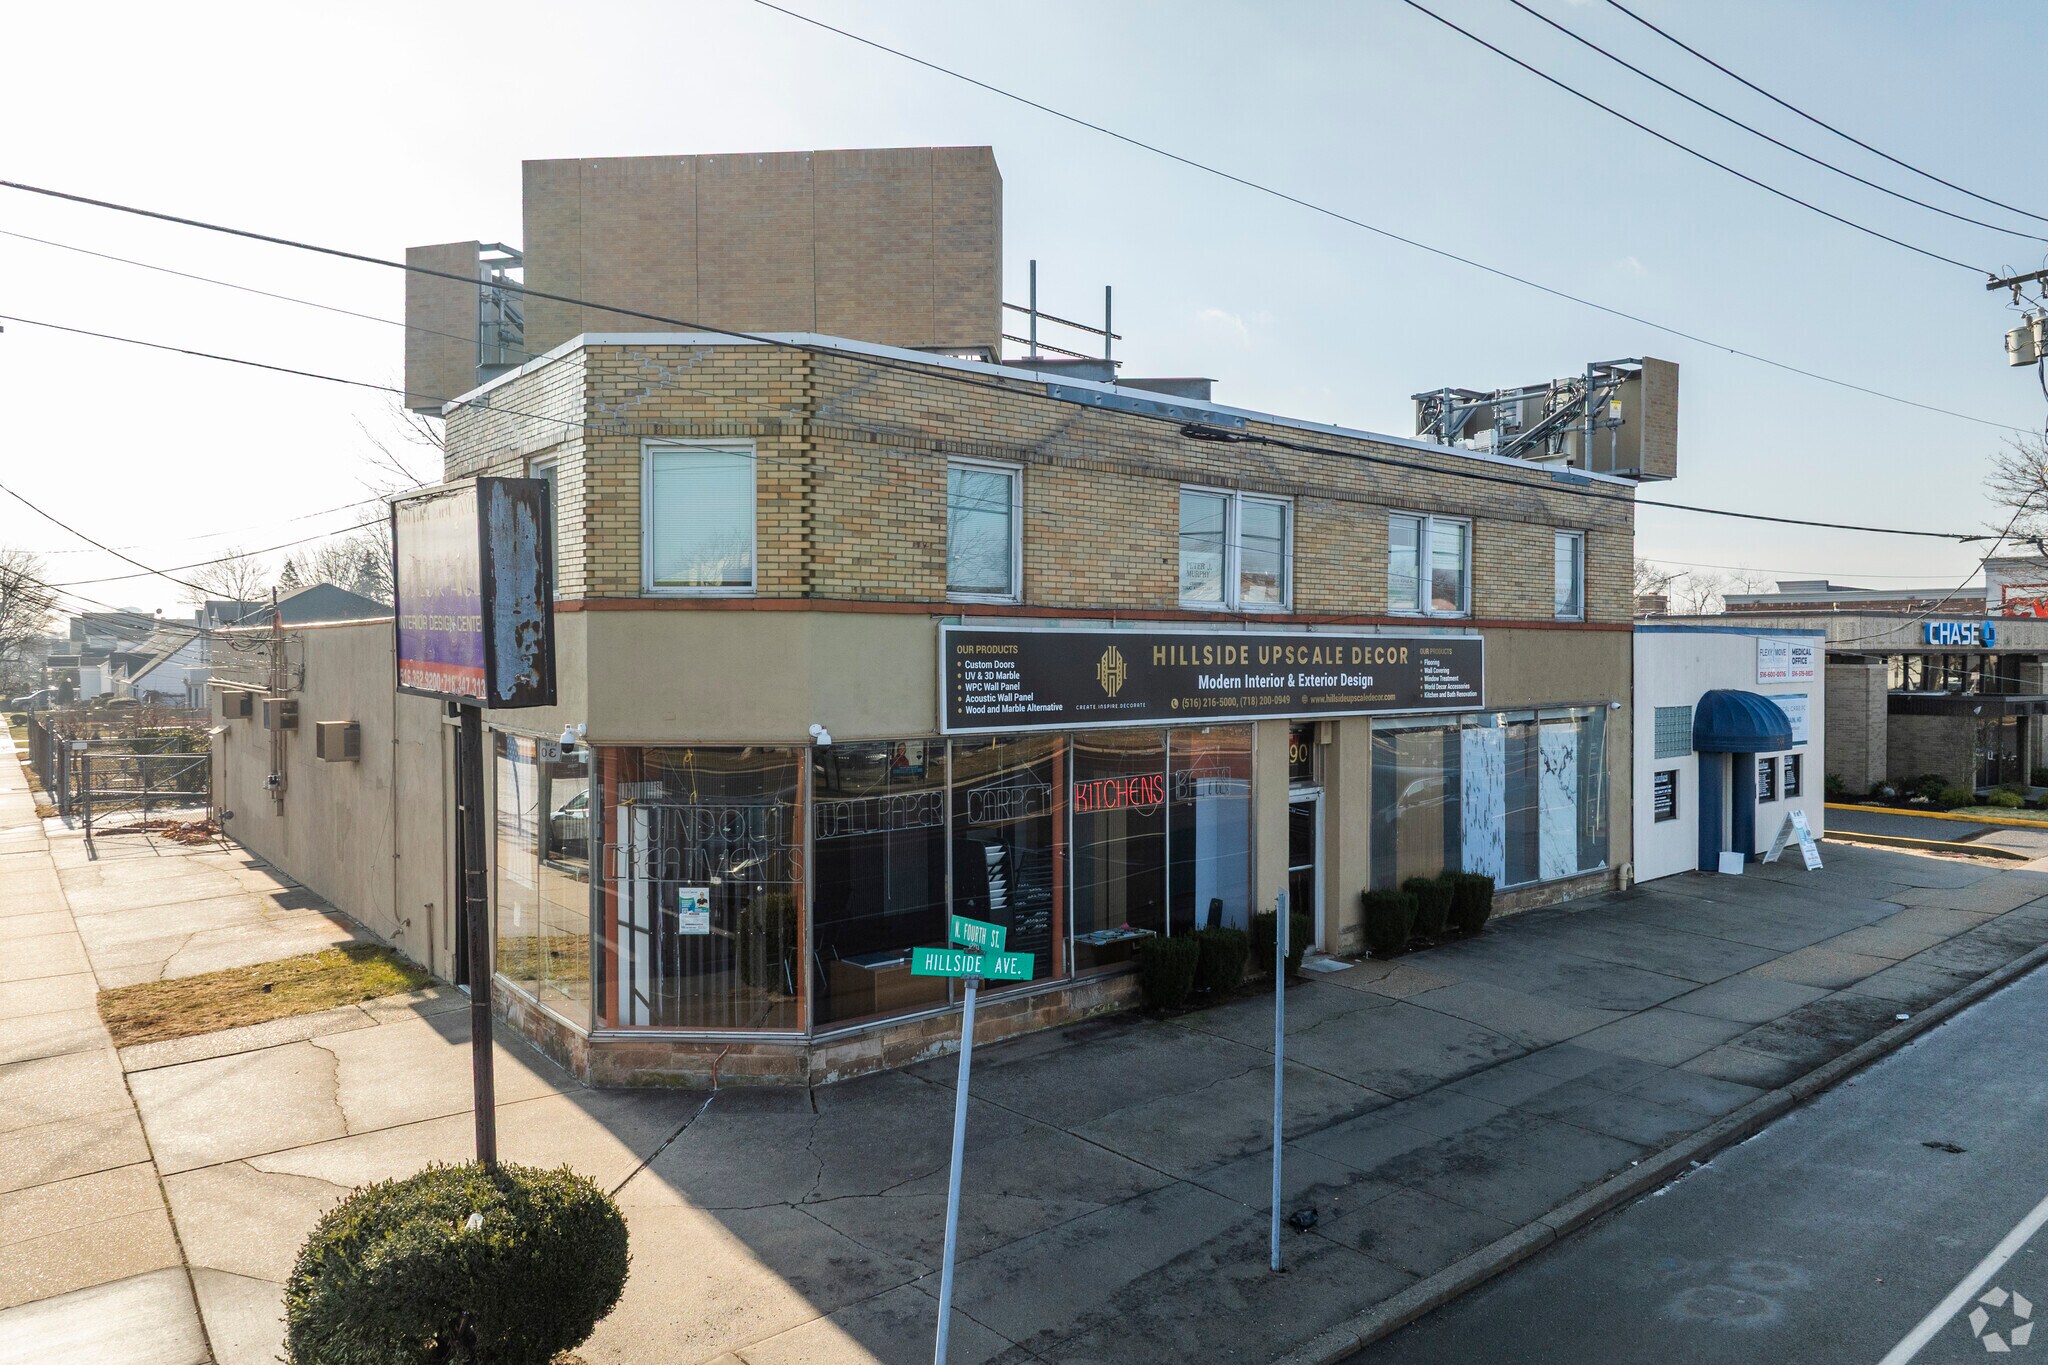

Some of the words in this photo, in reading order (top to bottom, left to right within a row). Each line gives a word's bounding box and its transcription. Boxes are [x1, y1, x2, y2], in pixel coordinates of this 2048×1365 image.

[430, 615, 456, 630] DESIGN
[457, 616, 482, 632] CENTE
[1929, 622, 1980, 645] CHASE
[956, 645, 974, 654] OUR
[976, 645, 1018, 654] PRODUCTS
[1153, 645, 1249, 666] HILLSIDE
[1258, 646, 1343, 665] UPSCALE
[1352, 646, 1408, 665] DECOR
[965, 660, 992, 669] Custom
[994, 660, 1014, 668] Doors
[965, 672, 976, 680] UV
[984, 672, 994, 680] 3D
[996, 671, 1020, 680] Marble
[1198, 674, 1241, 690] Modern
[1245, 673, 1284, 688] Interior
[1288, 674, 1295, 688] &
[1298, 673, 1337, 687] Exterior
[1341, 672, 1373, 689] Design
[965, 683, 982, 691] WPC
[984, 682, 999, 691] Wall
[1001, 682, 1020, 690] Panel
[965, 694, 996, 703] Acoustic
[998, 693, 1012, 702] Wall
[1014, 692, 1033, 701] Panel
[1182, 697, 1200, 709] (516)
[1203, 697, 1238, 708] 216-5000,
[1240, 696, 1258, 708] (718)
[1260, 695, 1290, 705] 200-0949
[1310, 693, 1396, 704] www.hillsideupscaledecor.com
[966, 705, 985, 714] Wood
[987, 705, 999, 713] and
[1001, 704, 1025, 713] Marble
[1027, 703, 1063, 712] Alternative
[1290, 744, 1308, 763] 90
[1075, 774, 1164, 812] KITCHENS
[969, 787, 1050, 823] CARPET
[816, 792, 943, 838] WALLPAPER
[955, 921, 960, 938] N.
[964, 923, 986, 944] FOURTH
[991, 930, 999, 948] ST.
[926, 954, 982, 973] HILLSIDE
[994, 957, 1021, 975] AVE.
